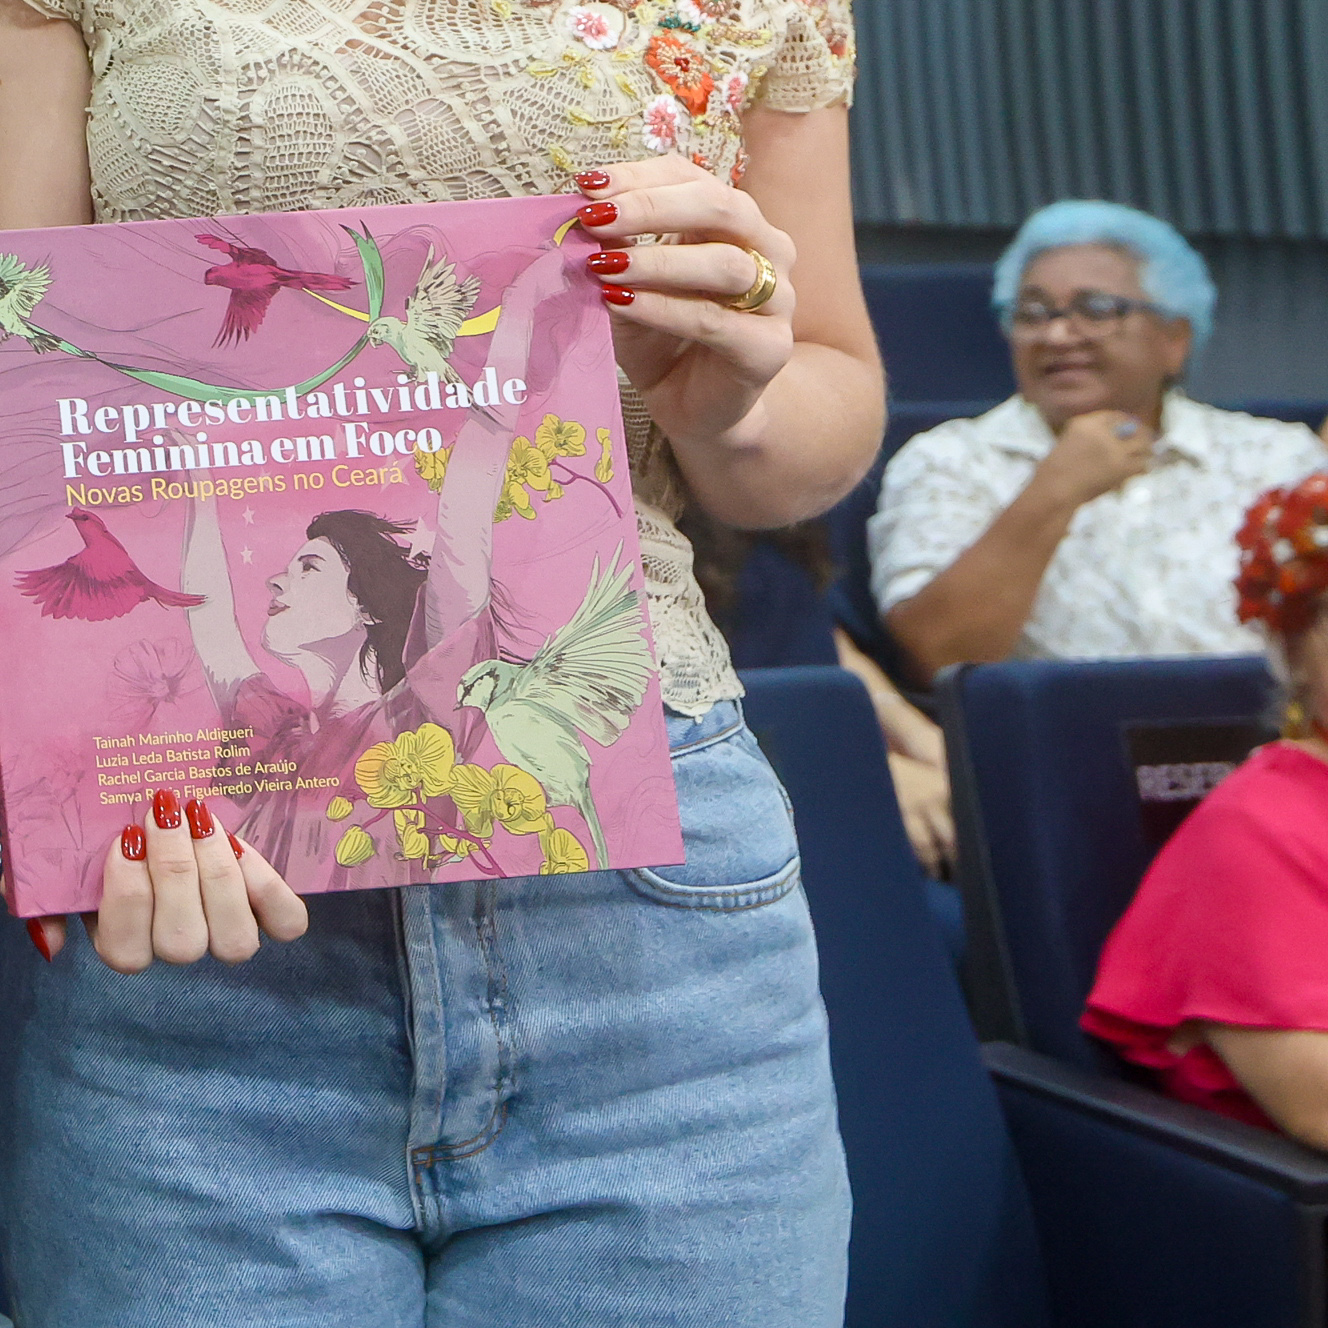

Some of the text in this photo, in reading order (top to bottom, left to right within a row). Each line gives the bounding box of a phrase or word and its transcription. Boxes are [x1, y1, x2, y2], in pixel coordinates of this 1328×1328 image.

[56, 366, 528, 444] Representatividade
[60, 422, 443, 479] Feminina em Foco
[65, 461, 404, 507] Novas Roupagens no Ceará
[93, 725, 254, 749] Tainah Marinho Aldigueri
[95, 745, 251, 768] Luzia Leda Batista Rolim
[98, 759, 297, 786] Rachel Garcia Bastos de Araújo
[99, 789, 142, 805] Samya
[254, 779, 293, 793] Vieira
[295, 775, 340, 790] Antero
